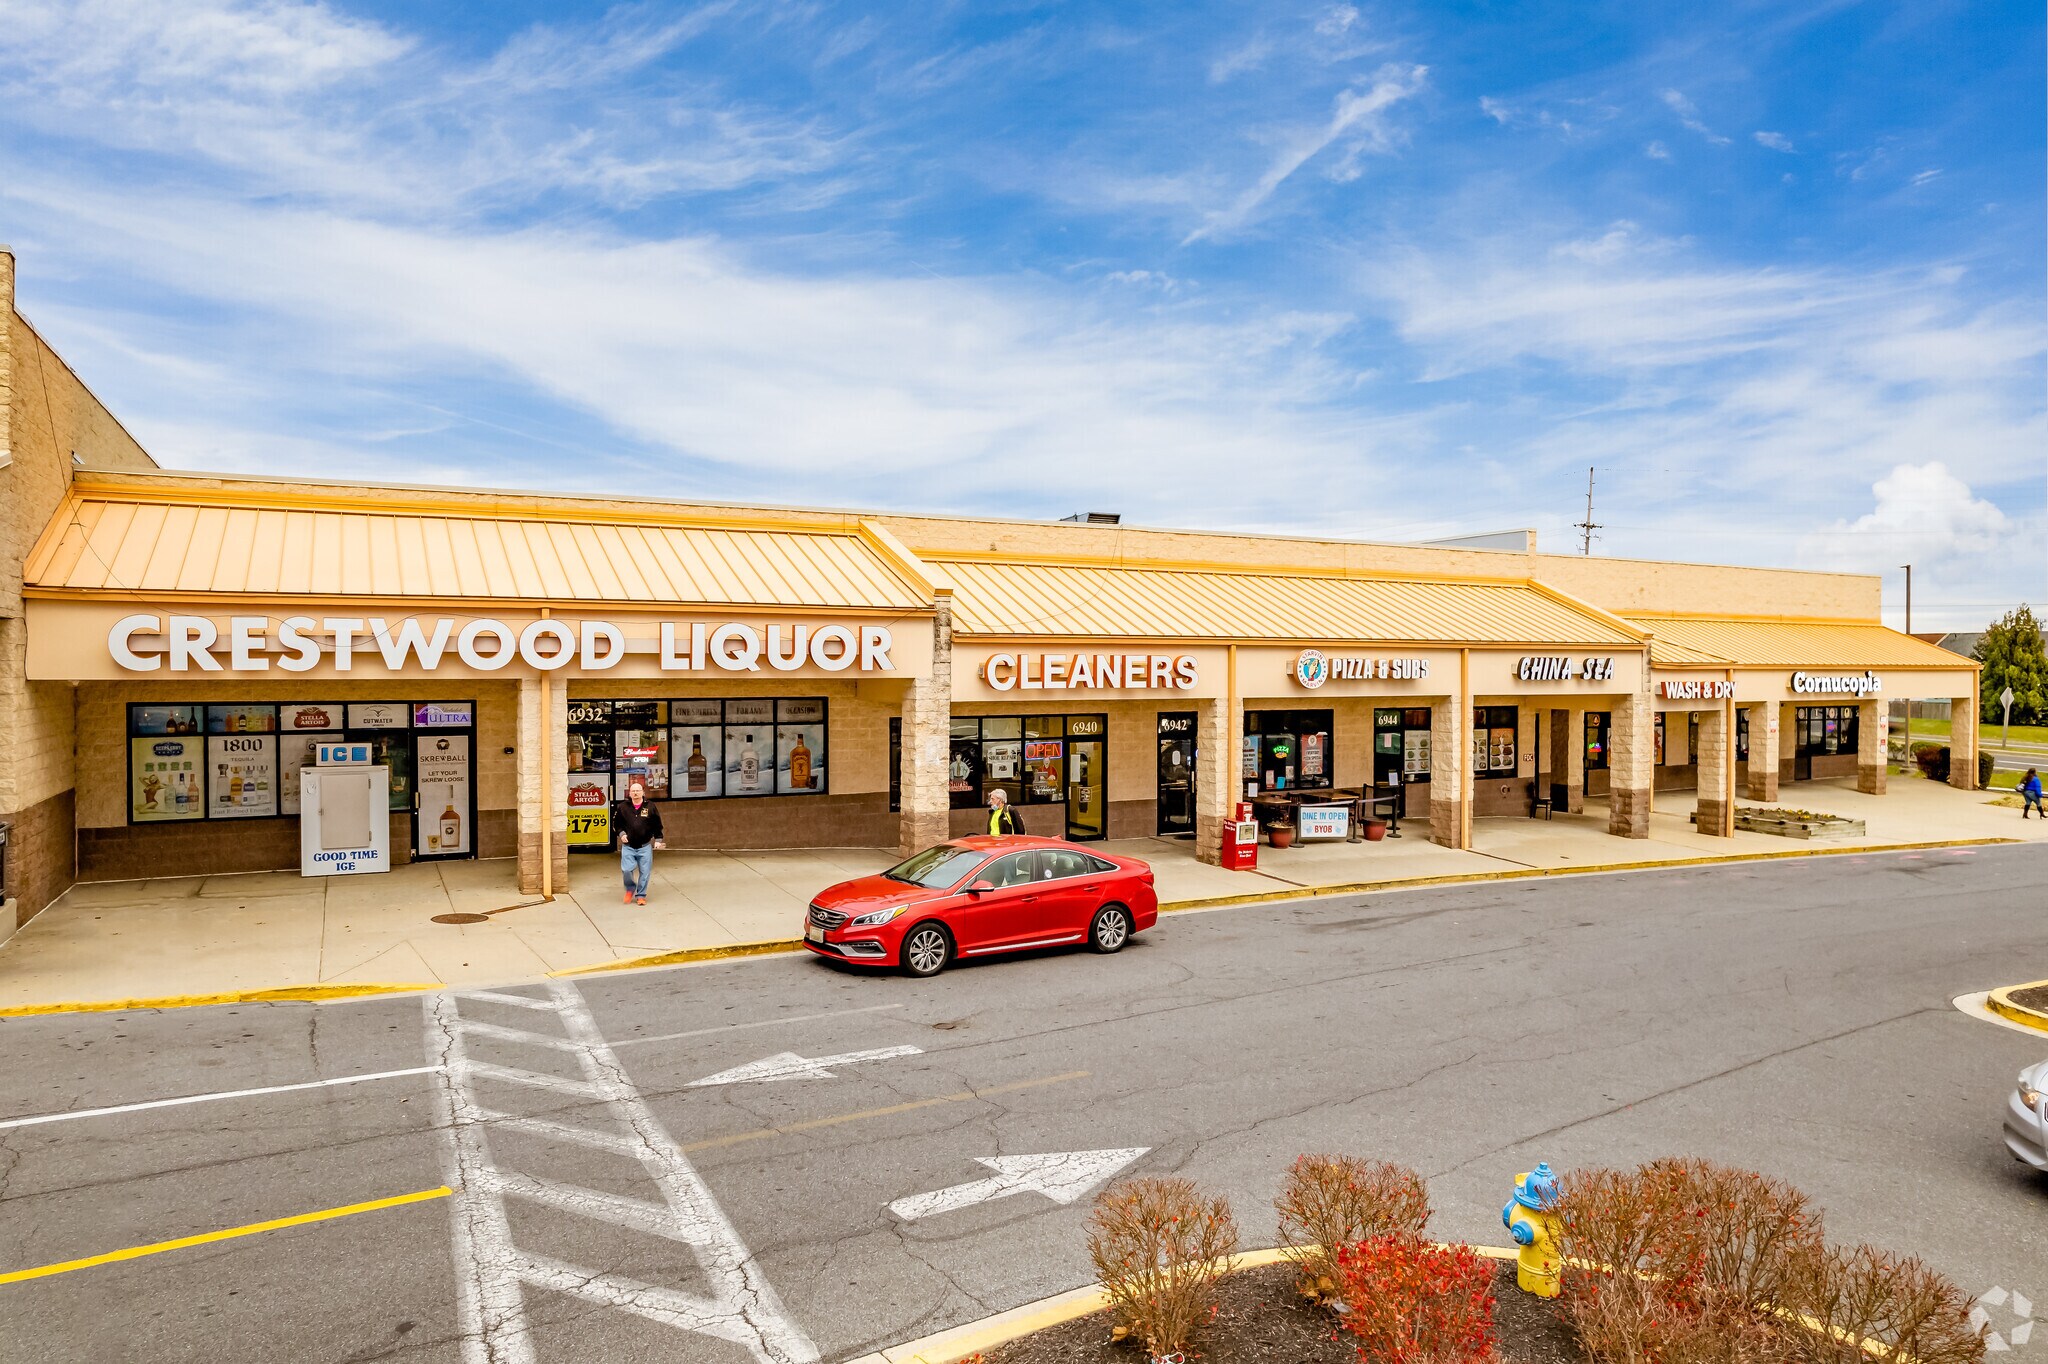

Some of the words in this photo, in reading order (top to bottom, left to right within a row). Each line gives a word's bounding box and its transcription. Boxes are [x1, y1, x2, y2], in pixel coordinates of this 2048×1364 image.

[108, 614, 626, 672] CRESTWOOD
[660, 621, 896, 672] LIQUOR
[986, 653, 1199, 692] CLEANERS
[1332, 658, 1373, 679] PIZZA
[1378, 659, 1388, 679] &
[1392, 659, 1430, 679] SUBS
[1519, 657, 1573, 680] CHINA
[1583, 657, 1615, 680] SEA
[1665, 681, 1701, 699] WASH
[1703, 681, 1713, 698] &
[1714, 681, 1737, 698] DRY
[1793, 670, 1882, 698] Cornucopia
[568, 707, 603, 722] 6932
[675, 708, 690, 716] FINE
[785, 706, 816, 714] OCCASION
[429, 714, 469, 723] ULTRA
[1378, 715, 1397, 725] 6944
[1072, 721, 1098, 733] 6940
[1164, 719, 1188, 731] 6942
[223, 738, 263, 752] 1800
[1026, 743, 1060, 758] OPEN
[1273, 745, 1290, 754] PIZZA
[320, 747, 368, 762] ICE
[624, 748, 657, 756] Budweiser
[1302, 812, 1318, 820] DINE
[1319, 812, 1327, 820] IN
[1328, 811, 1347, 820] OPEN
[1314, 825, 1333, 833] BYOB
[313, 852, 347, 862] GOOD
[350, 850, 379, 860] TIME
[336, 862, 356, 871] ICE
